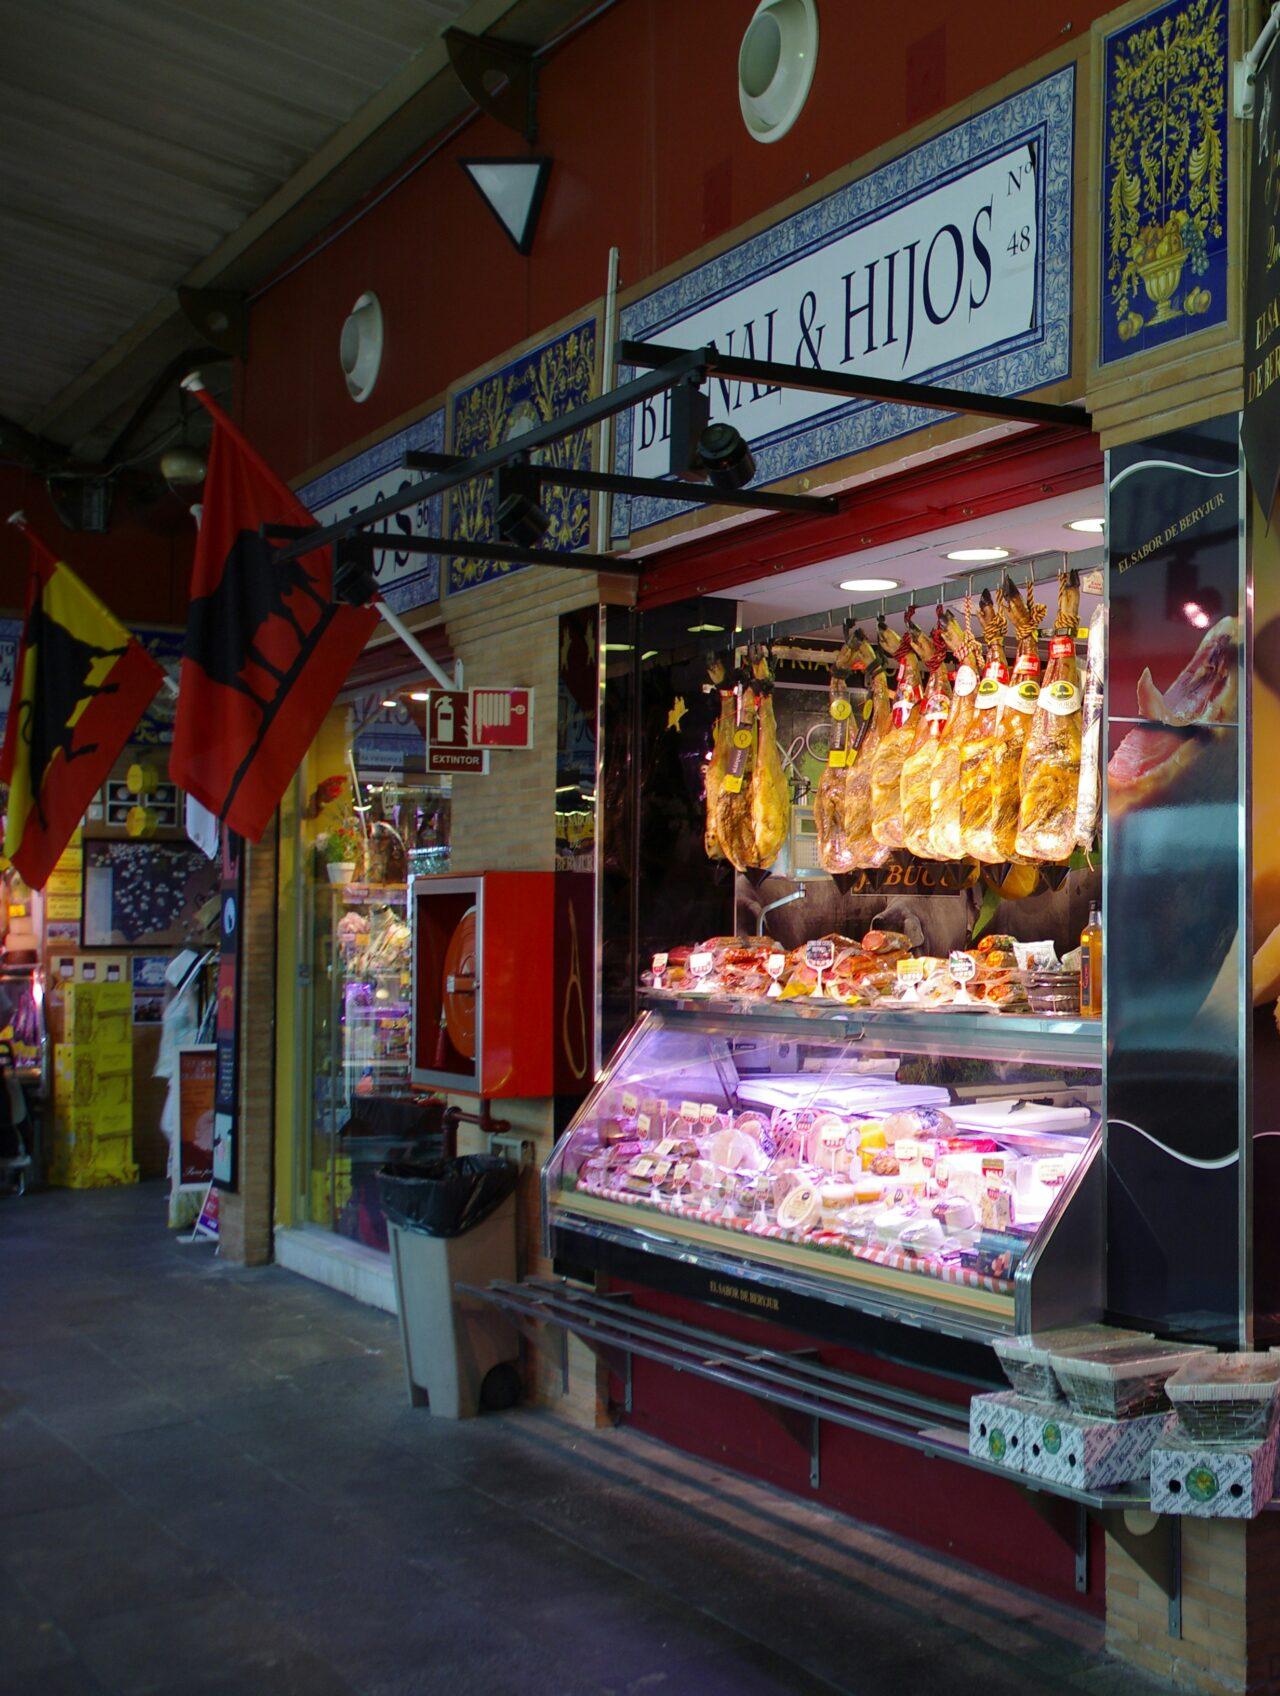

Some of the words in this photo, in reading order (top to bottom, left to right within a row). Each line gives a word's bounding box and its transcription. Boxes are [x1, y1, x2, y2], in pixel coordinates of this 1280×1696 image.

[1006, 225, 1031, 257] 48
[637, 308, 783, 452] BENAL
[795, 290, 827, 369] &
[839, 193, 994, 371] HIJOS
[1255, 313, 1268, 351] EL
[1247, 363, 1263, 405] DE
[1117, 557, 1131, 575] EL
[1131, 534, 1163, 563] SABOR
[1164, 523, 1180, 542] DE
[1179, 492, 1226, 533] BERYJUR
[432, 753, 481, 766] EXTINTOR
